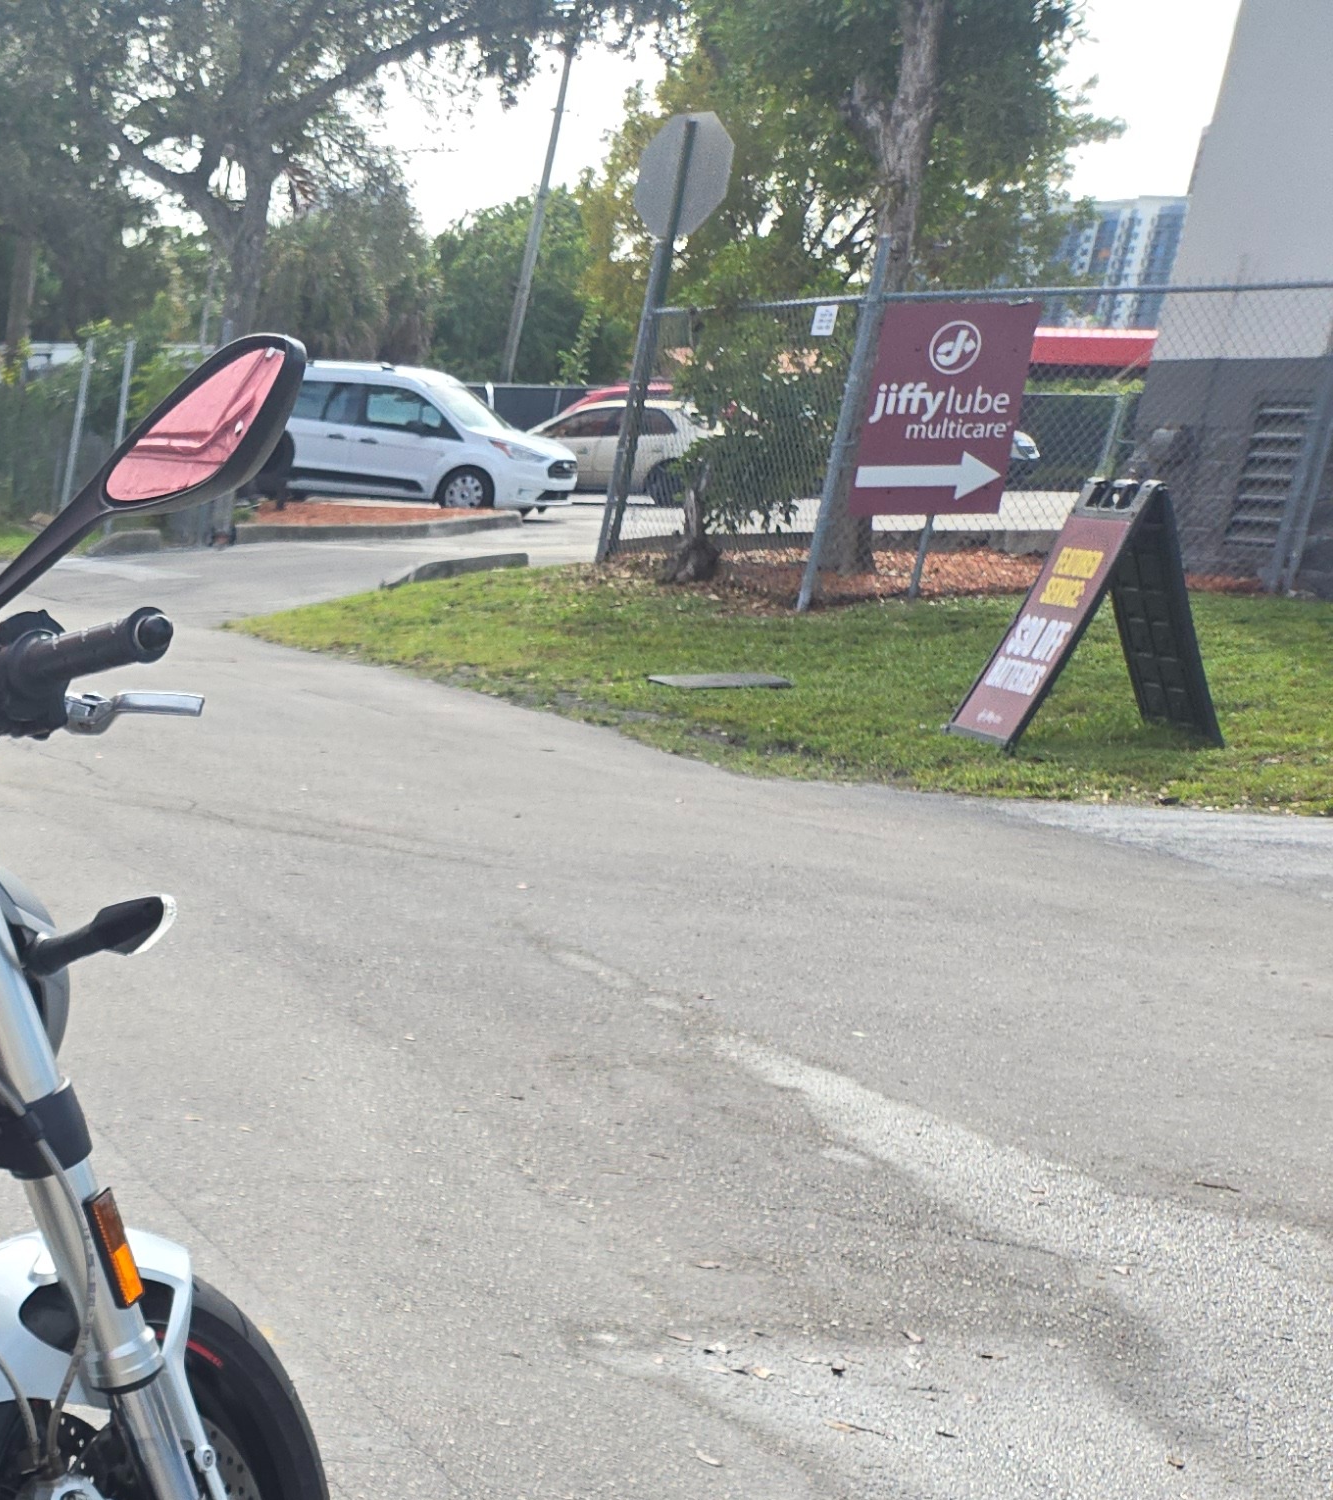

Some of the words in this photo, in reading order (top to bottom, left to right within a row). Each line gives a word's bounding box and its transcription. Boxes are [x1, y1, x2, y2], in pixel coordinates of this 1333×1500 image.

[868, 382, 945, 424] jiffy
[945, 385, 1010, 414] lube
[905, 417, 1007, 439] multicare
[1031, 619, 1073, 662] OFF
